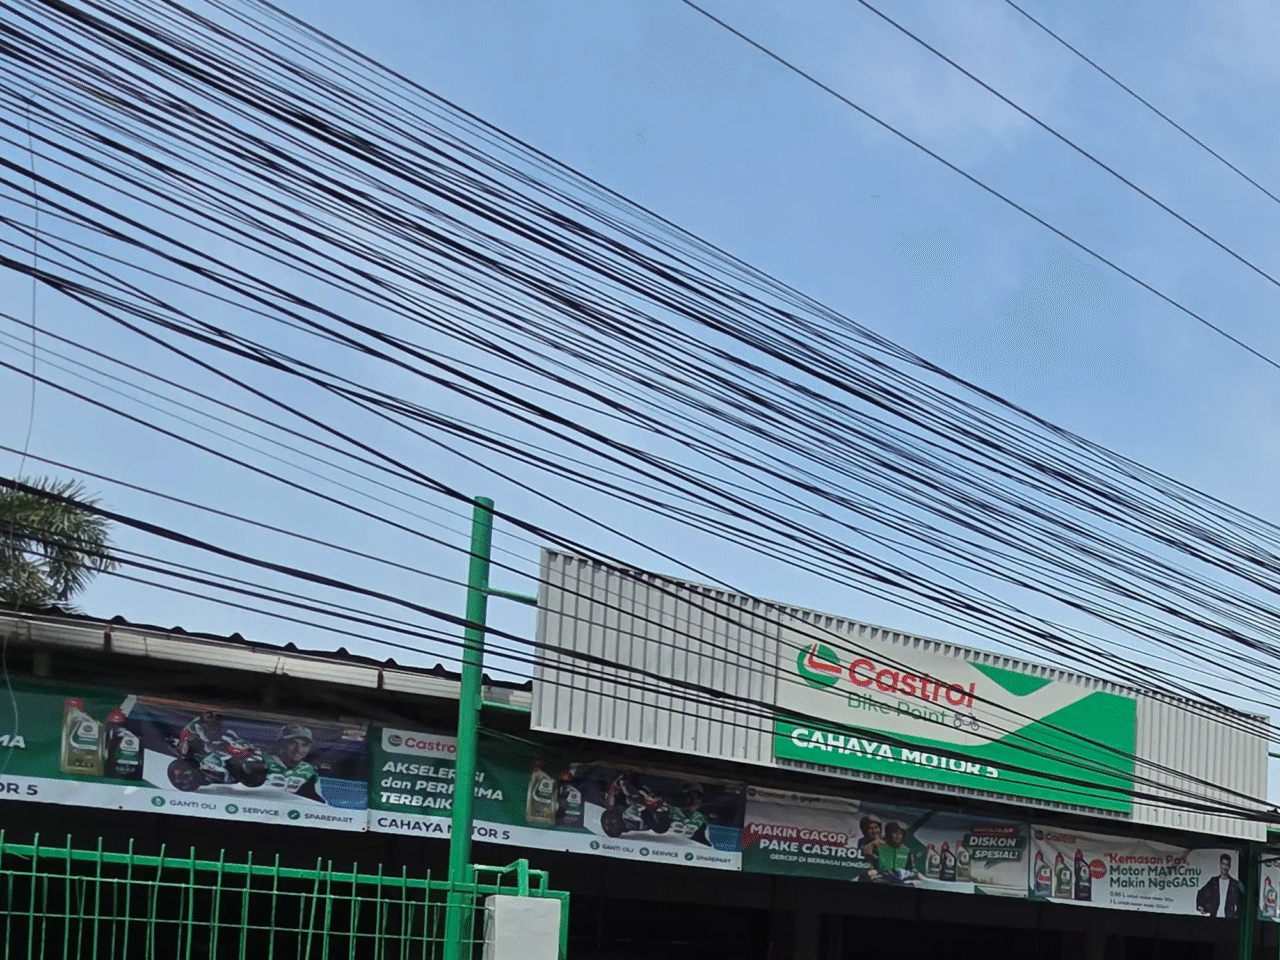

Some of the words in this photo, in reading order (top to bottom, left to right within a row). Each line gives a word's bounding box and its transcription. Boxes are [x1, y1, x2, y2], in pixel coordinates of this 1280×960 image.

[848, 657, 976, 708] Castrol
[848, 693, 890, 714] Bike
[897, 700, 948, 725] Point
[404, 737, 457, 754] Castro
[791, 728, 894, 762] CAHAYA
[900, 748, 981, 777] MOTOR
[26, 784, 39, 796] 5
[380, 776, 412, 790] dan
[380, 791, 453, 810] TERBAIK
[169, 798, 199, 809] GANTI
[201, 801, 218, 811] OLI
[242, 806, 281, 818] SERVICE
[304, 812, 354, 825] SPAREPART
[377, 817, 444, 834] CAHAYA
[501, 830, 511, 841] 5
[749, 823, 798, 838] MAKIN
[799, 830, 847, 845] GACOR
[758, 839, 798, 854] PAKE
[801, 843, 865, 860] CASTROL
[968, 836, 1017, 848] DISKON
[651, 849, 679, 859] SERVICE
[695, 854, 732, 864] SPAREPART
[974, 849, 1019, 860] SPESIAL!
[1165, 855, 1190, 867] Pas,
[1109, 865, 1145, 877] Motor
[1147, 866, 1202, 877] MATICmu
[1109, 876, 1146, 889] Makin
[1148, 877, 1200, 891] NgeGAS!
